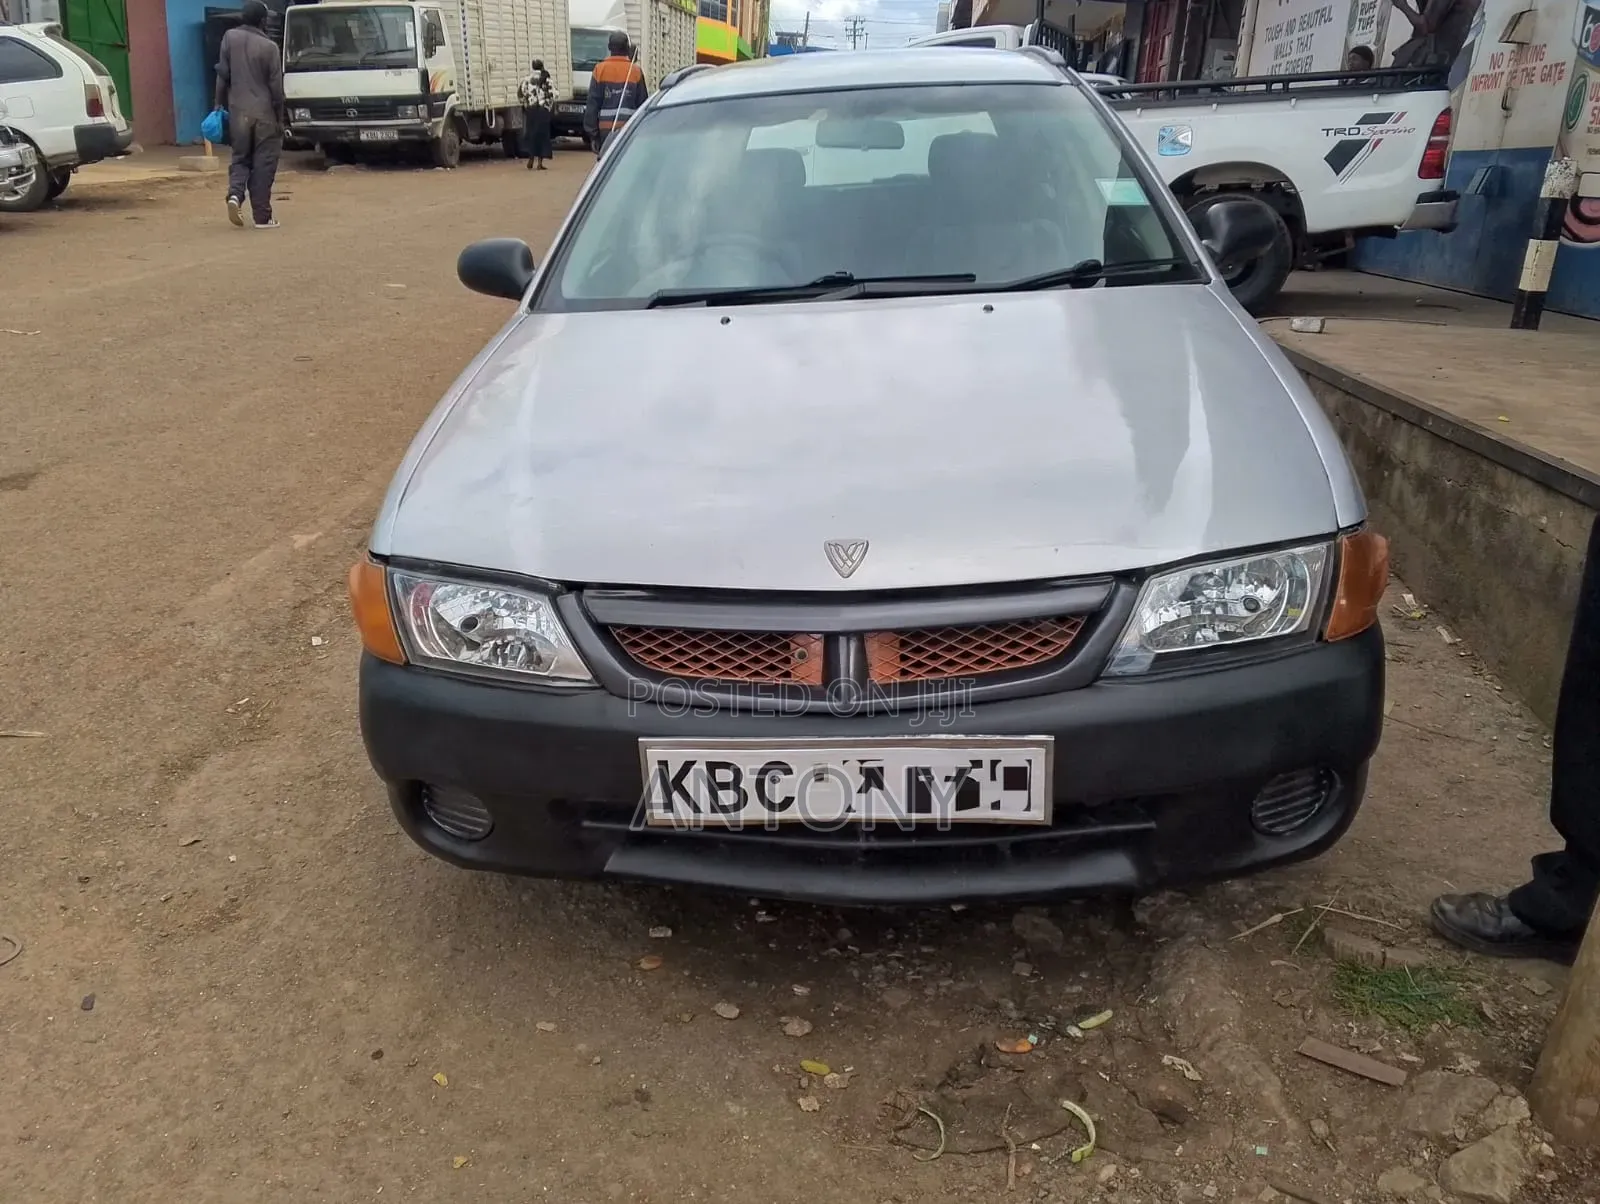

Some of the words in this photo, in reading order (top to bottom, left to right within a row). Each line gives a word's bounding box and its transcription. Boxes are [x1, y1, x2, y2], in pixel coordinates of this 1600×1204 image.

[1359, 1, 1377, 16] RUFF
[1264, 22, 1284, 44] TOUGH
[1285, 18, 1297, 37] AND
[1298, 5, 1333, 31] BEAUTIFUL
[1357, 14, 1375, 31] TUFF
[1273, 40, 1294, 61] WALLS
[1296, 33, 1315, 54] THAT
[1489, 51, 1504, 70] NO
[1507, 43, 1547, 67] PARKING
[1470, 71, 1504, 93] INFRONT
[1520, 66, 1536, 86] THE
[1540, 61, 1566, 86] GATE
[341, 96, 360, 104] TATA
[1321, 126, 1361, 138] TRD
[656, 760, 796, 814] KBC
